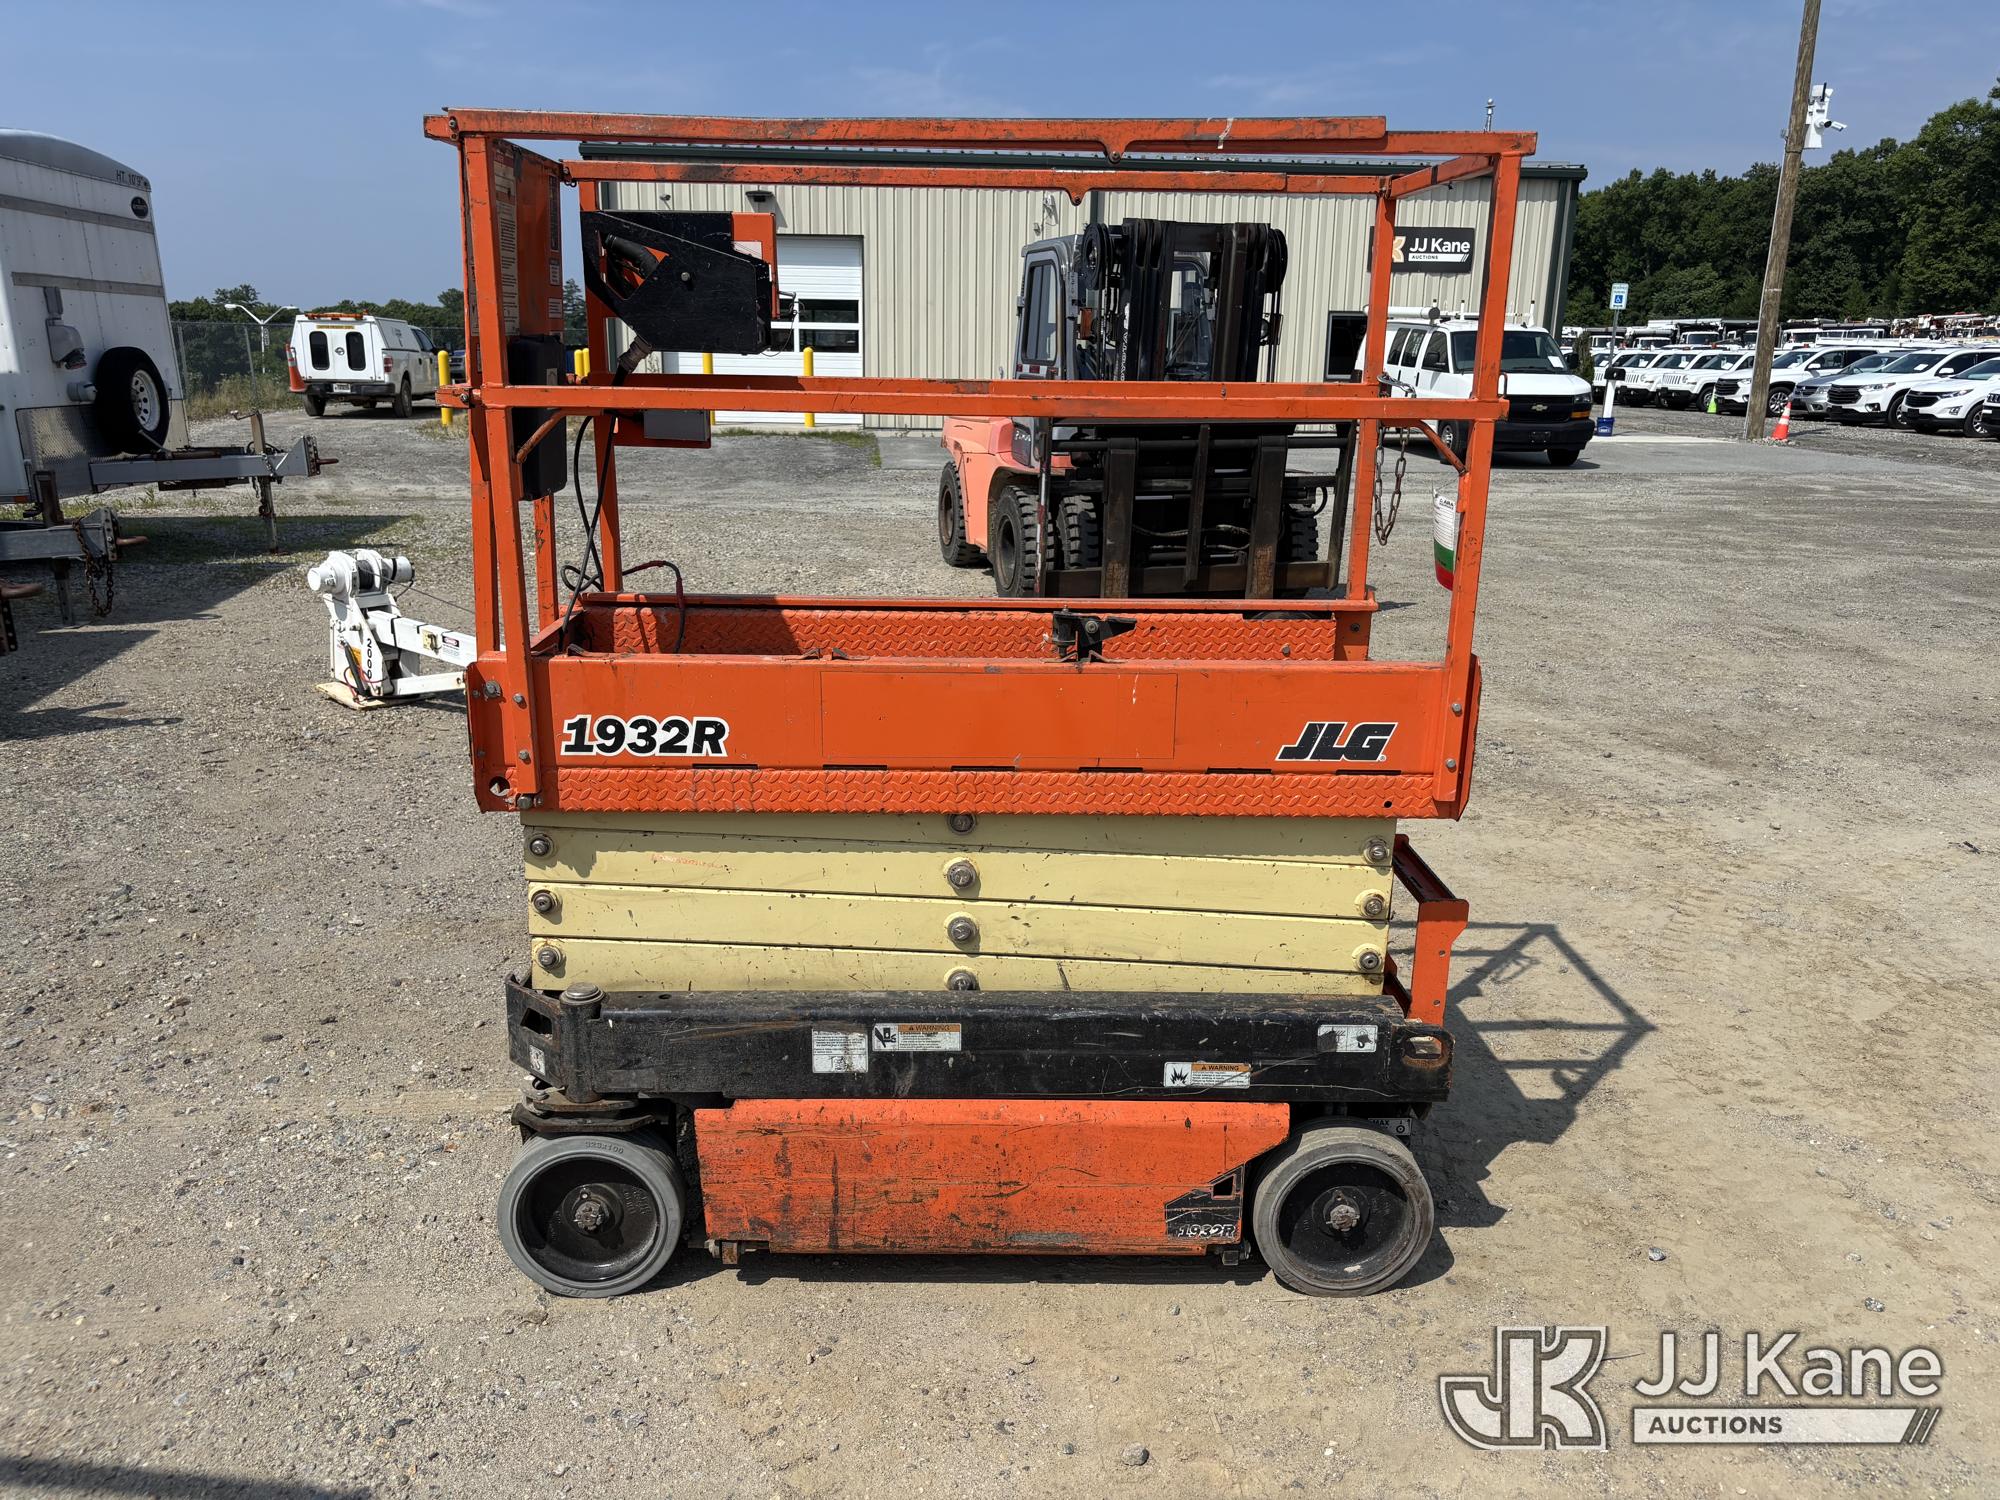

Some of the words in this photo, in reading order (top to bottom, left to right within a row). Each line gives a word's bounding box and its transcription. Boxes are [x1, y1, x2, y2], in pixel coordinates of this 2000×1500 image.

[1409, 237, 1428, 252] JJ
[1430, 238, 1471, 253] Kane
[1120, 331, 1129, 381] OYOTA
[560, 714, 730, 757] 1932R
[1275, 721, 1398, 762] JLG
[1177, 1223, 1236, 1240] 1932R
